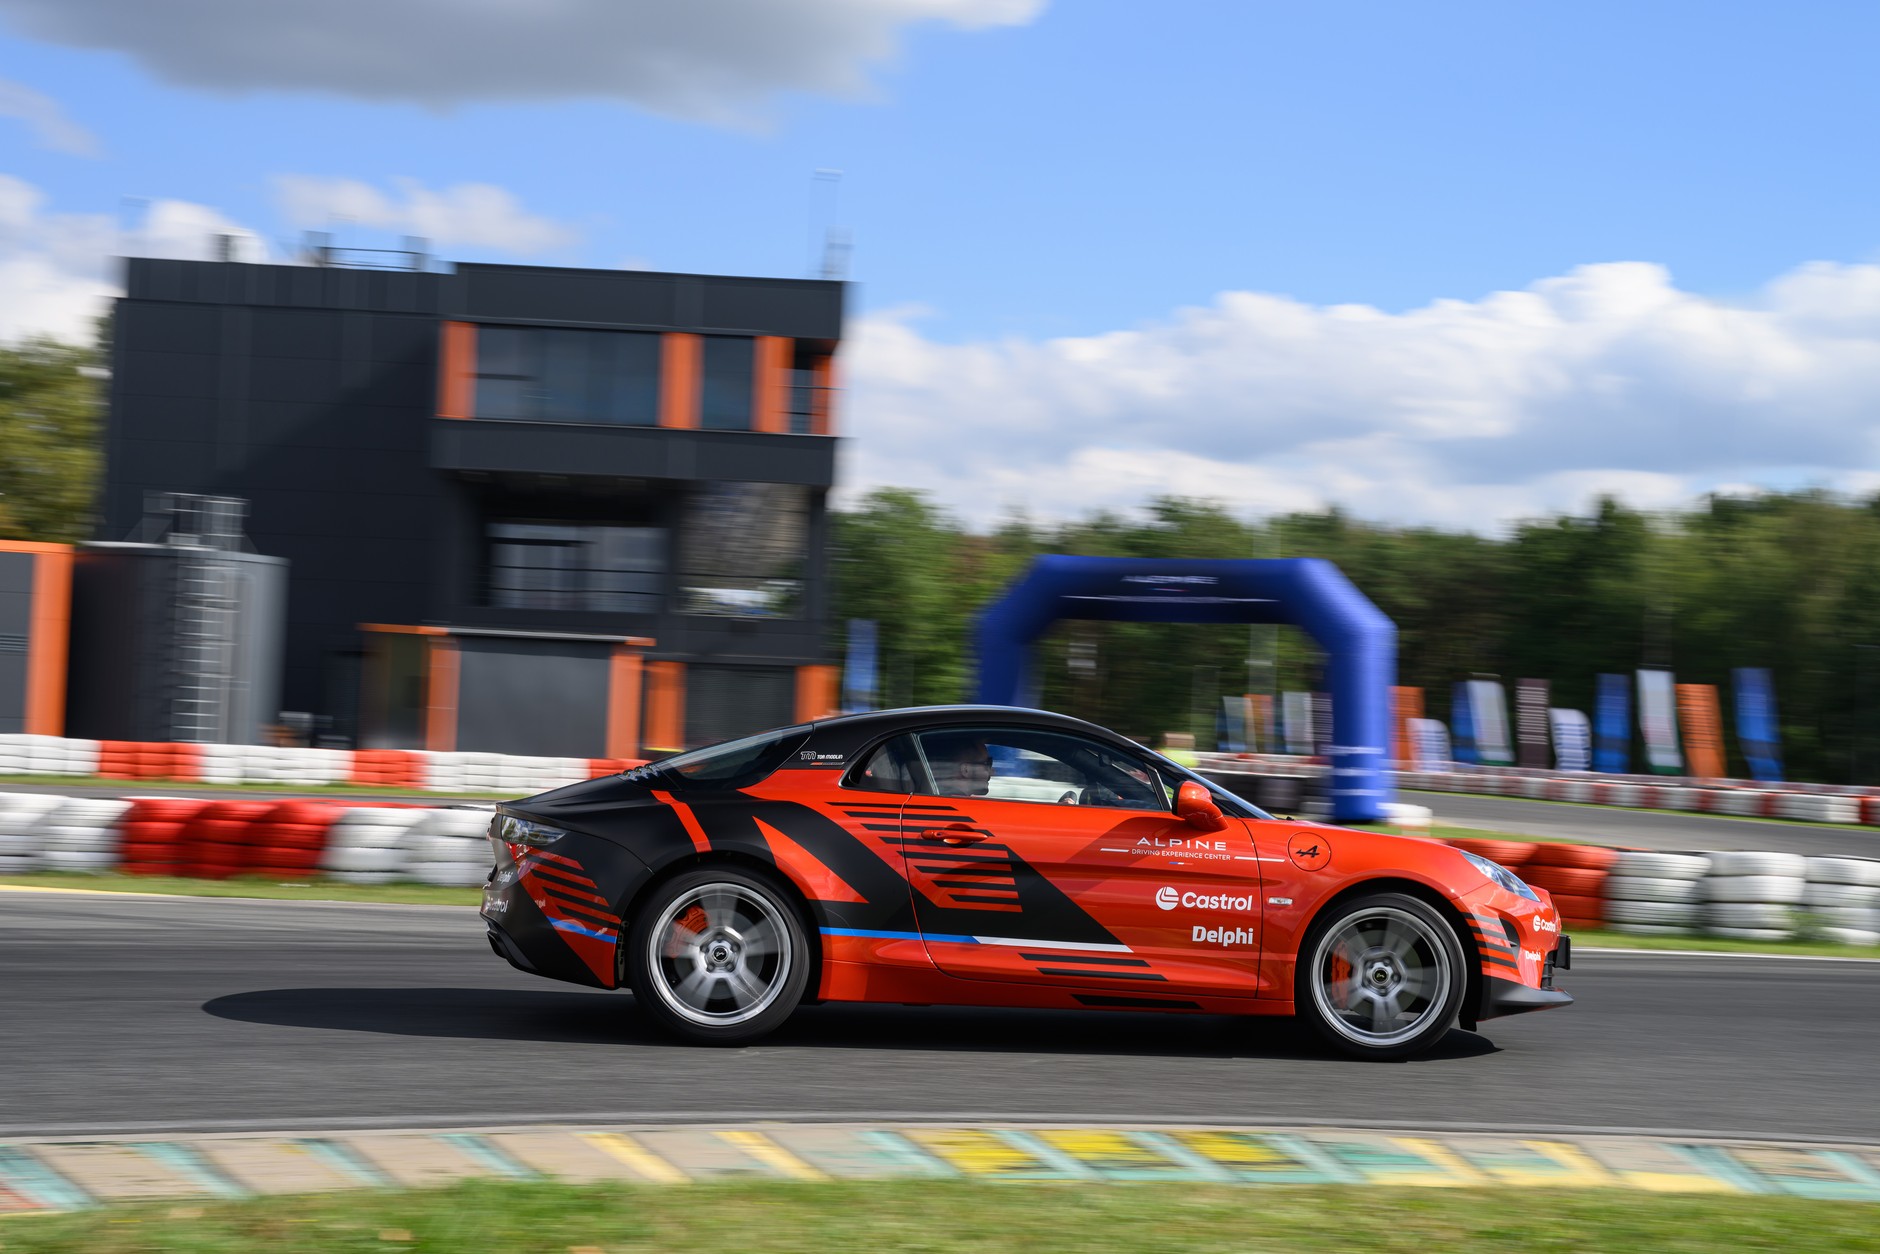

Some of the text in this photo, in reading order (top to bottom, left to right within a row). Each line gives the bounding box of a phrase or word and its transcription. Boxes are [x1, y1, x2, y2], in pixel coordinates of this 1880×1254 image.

[1137, 837, 1226, 851] ALPINE
[1132, 848, 1160, 856] DRIVING
[1162, 850, 1202, 859] EXPERIENCE
[1182, 891, 1253, 911] Castrol
[1192, 925, 1253, 947] Delphi
